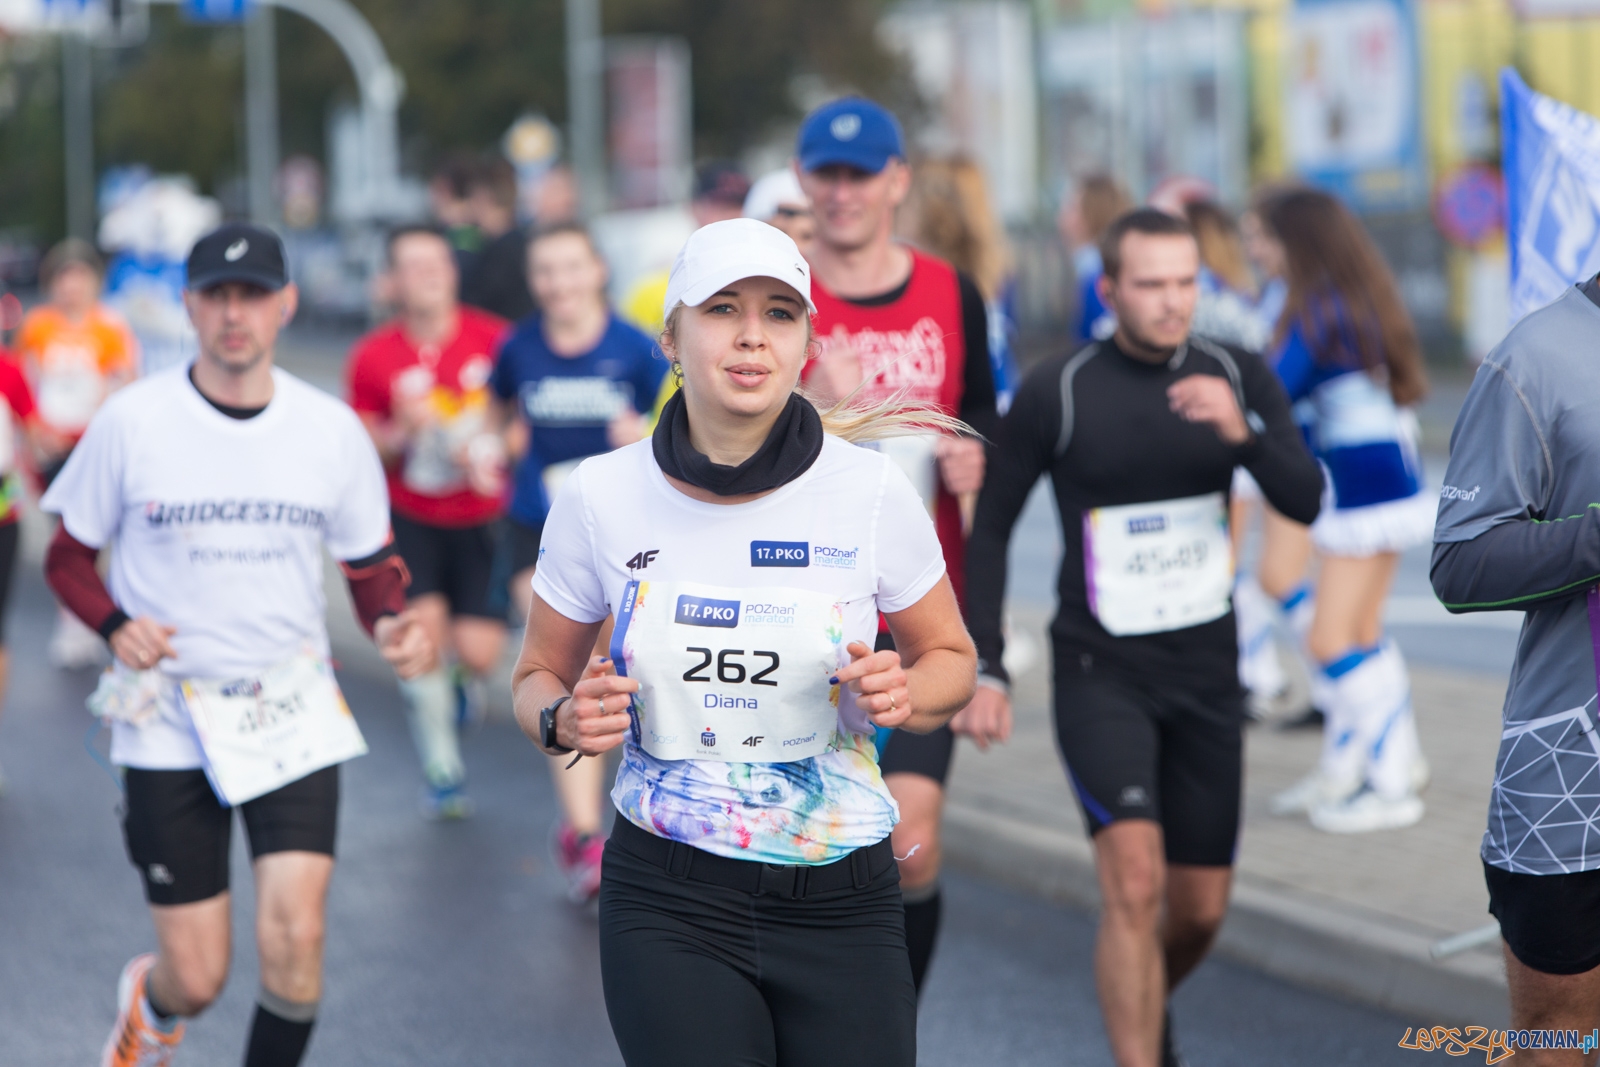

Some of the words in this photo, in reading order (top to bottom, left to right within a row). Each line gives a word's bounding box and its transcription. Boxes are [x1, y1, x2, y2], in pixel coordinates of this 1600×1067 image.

[626, 549, 660, 570] 4F
[756, 548, 773, 559] 17.
[775, 548, 805, 560] PKO
[814, 556, 857, 566] maraton
[682, 603, 701, 618] 17.
[702, 605, 735, 620] PKO
[744, 613, 795, 624] maraton
[682, 646, 780, 687] 262
[704, 693, 758, 709] Diana
[742, 736, 764, 747] 4F
